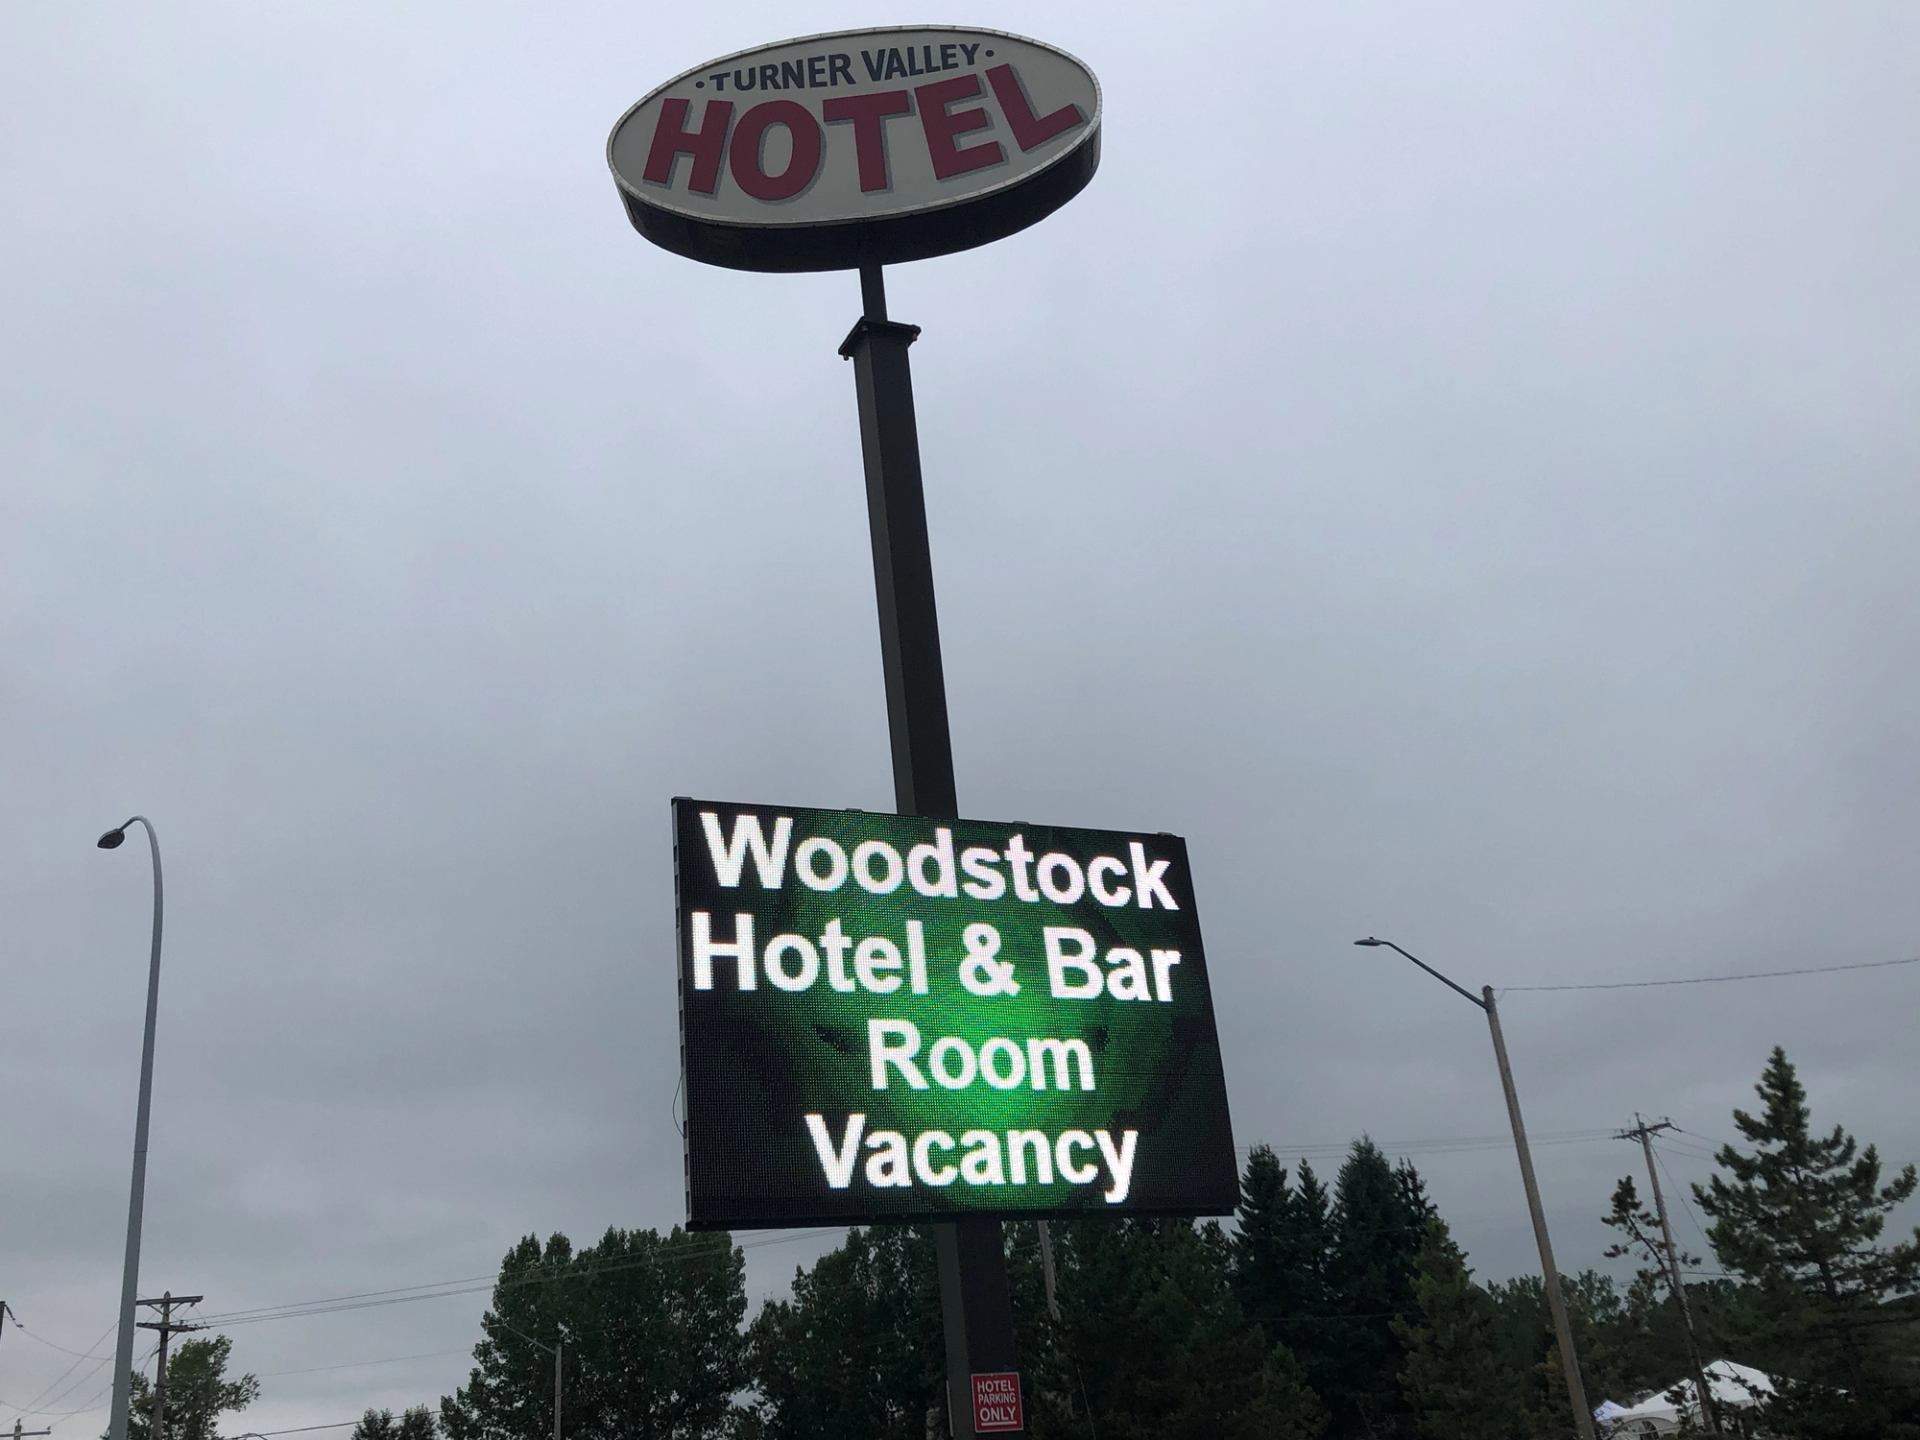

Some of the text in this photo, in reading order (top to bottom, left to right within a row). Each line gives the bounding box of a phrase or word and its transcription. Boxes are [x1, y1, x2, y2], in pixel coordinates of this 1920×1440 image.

[709, 43, 981, 91] TURNER VALLEY
[642, 64, 1085, 201] HOTEL
[699, 812, 1180, 911] Woodstock
[691, 911, 1182, 1003] Hotel & Bar
[867, 1018, 1096, 1092] Room
[804, 1113, 1139, 1204] Vacancy
[977, 1380, 1015, 1393] HOTEL
[978, 1392, 1016, 1405] PARKING
[980, 1406, 1016, 1421] ONLY
